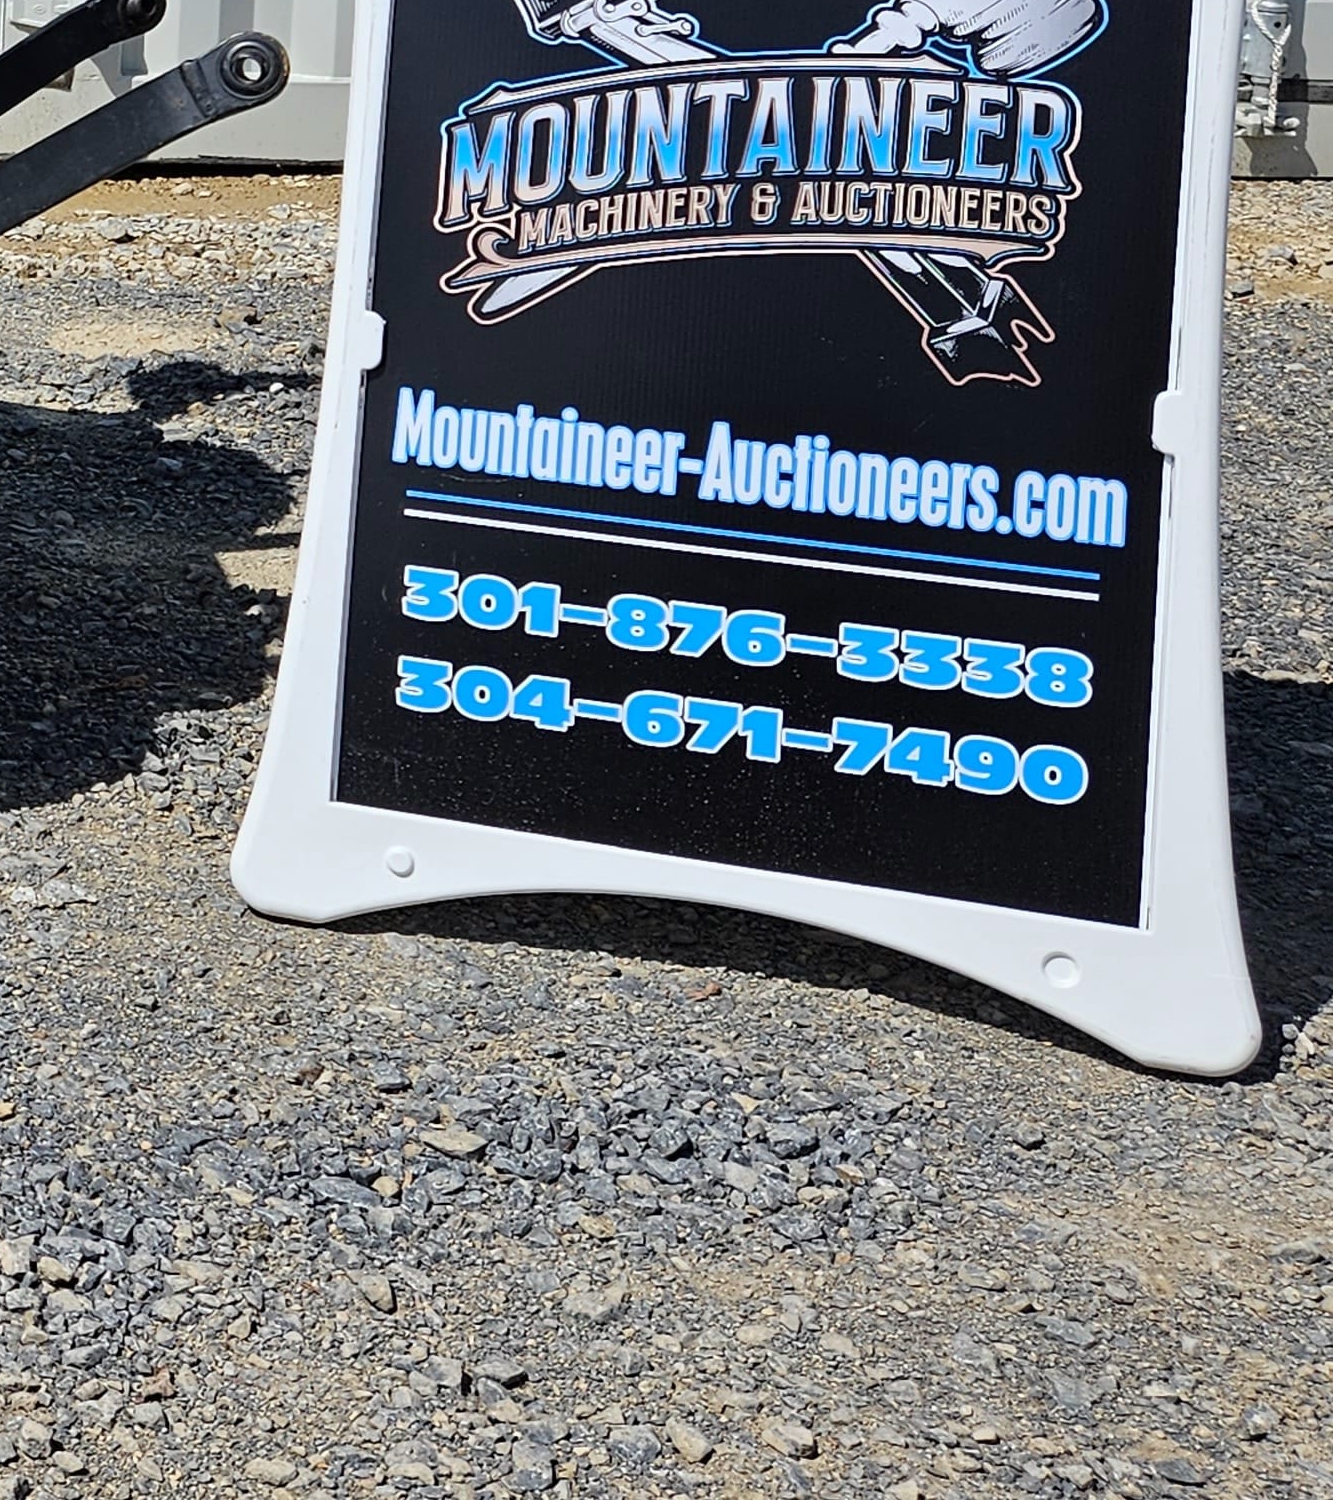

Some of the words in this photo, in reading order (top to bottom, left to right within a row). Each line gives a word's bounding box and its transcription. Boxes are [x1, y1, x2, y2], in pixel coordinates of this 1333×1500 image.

[447, 75, 1073, 225] MOUNTAINEER
[517, 184, 739, 253] MACHINERY
[749, 182, 779, 225] &
[791, 182, 1059, 237] AUCTIONEERS
[391, 386, 1129, 548] Mountaineer-Auctioneers.com
[401, 565, 1094, 707] 301-876-3338
[395, 655, 1089, 804] 304-671-7490
